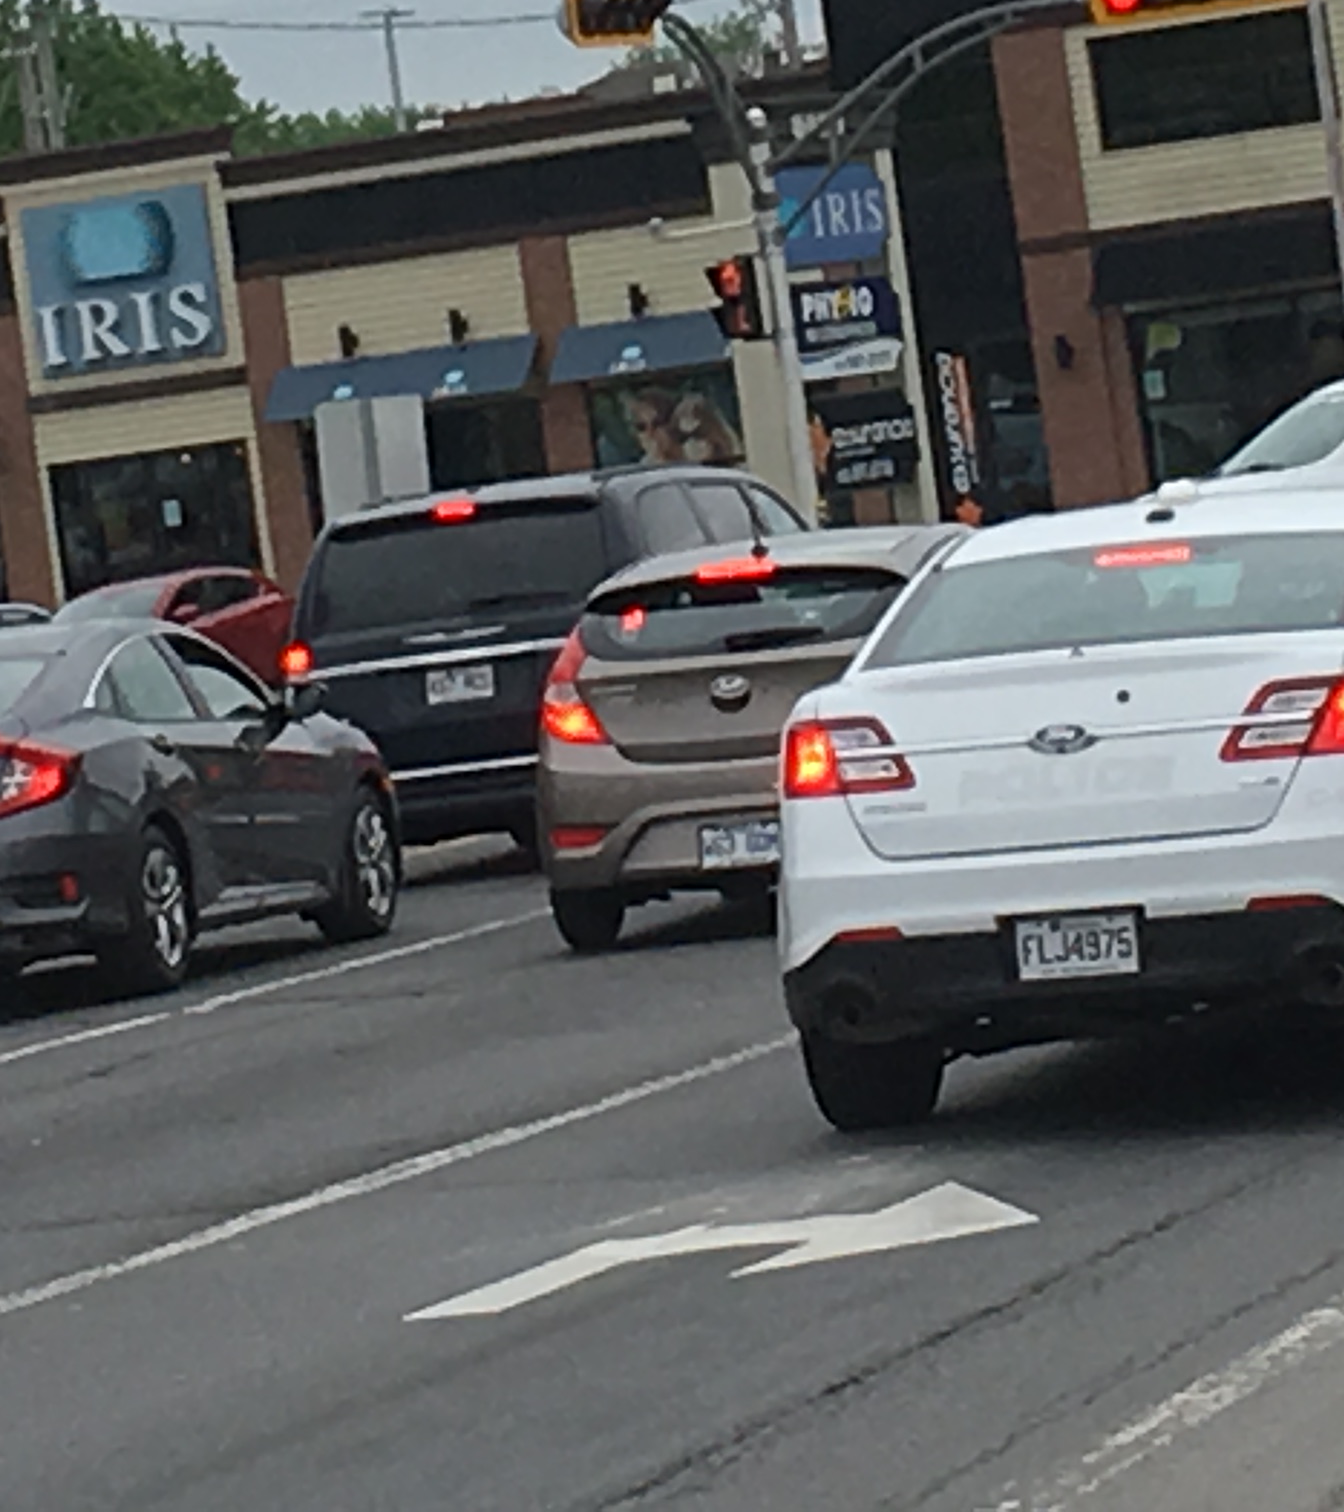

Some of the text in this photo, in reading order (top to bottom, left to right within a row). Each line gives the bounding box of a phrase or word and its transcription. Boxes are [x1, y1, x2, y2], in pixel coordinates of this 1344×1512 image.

[811, 188, 884, 237] IRIS
[37, 281, 213, 367] IRIS
[1021, 925, 1134, 966] FLJ4975
